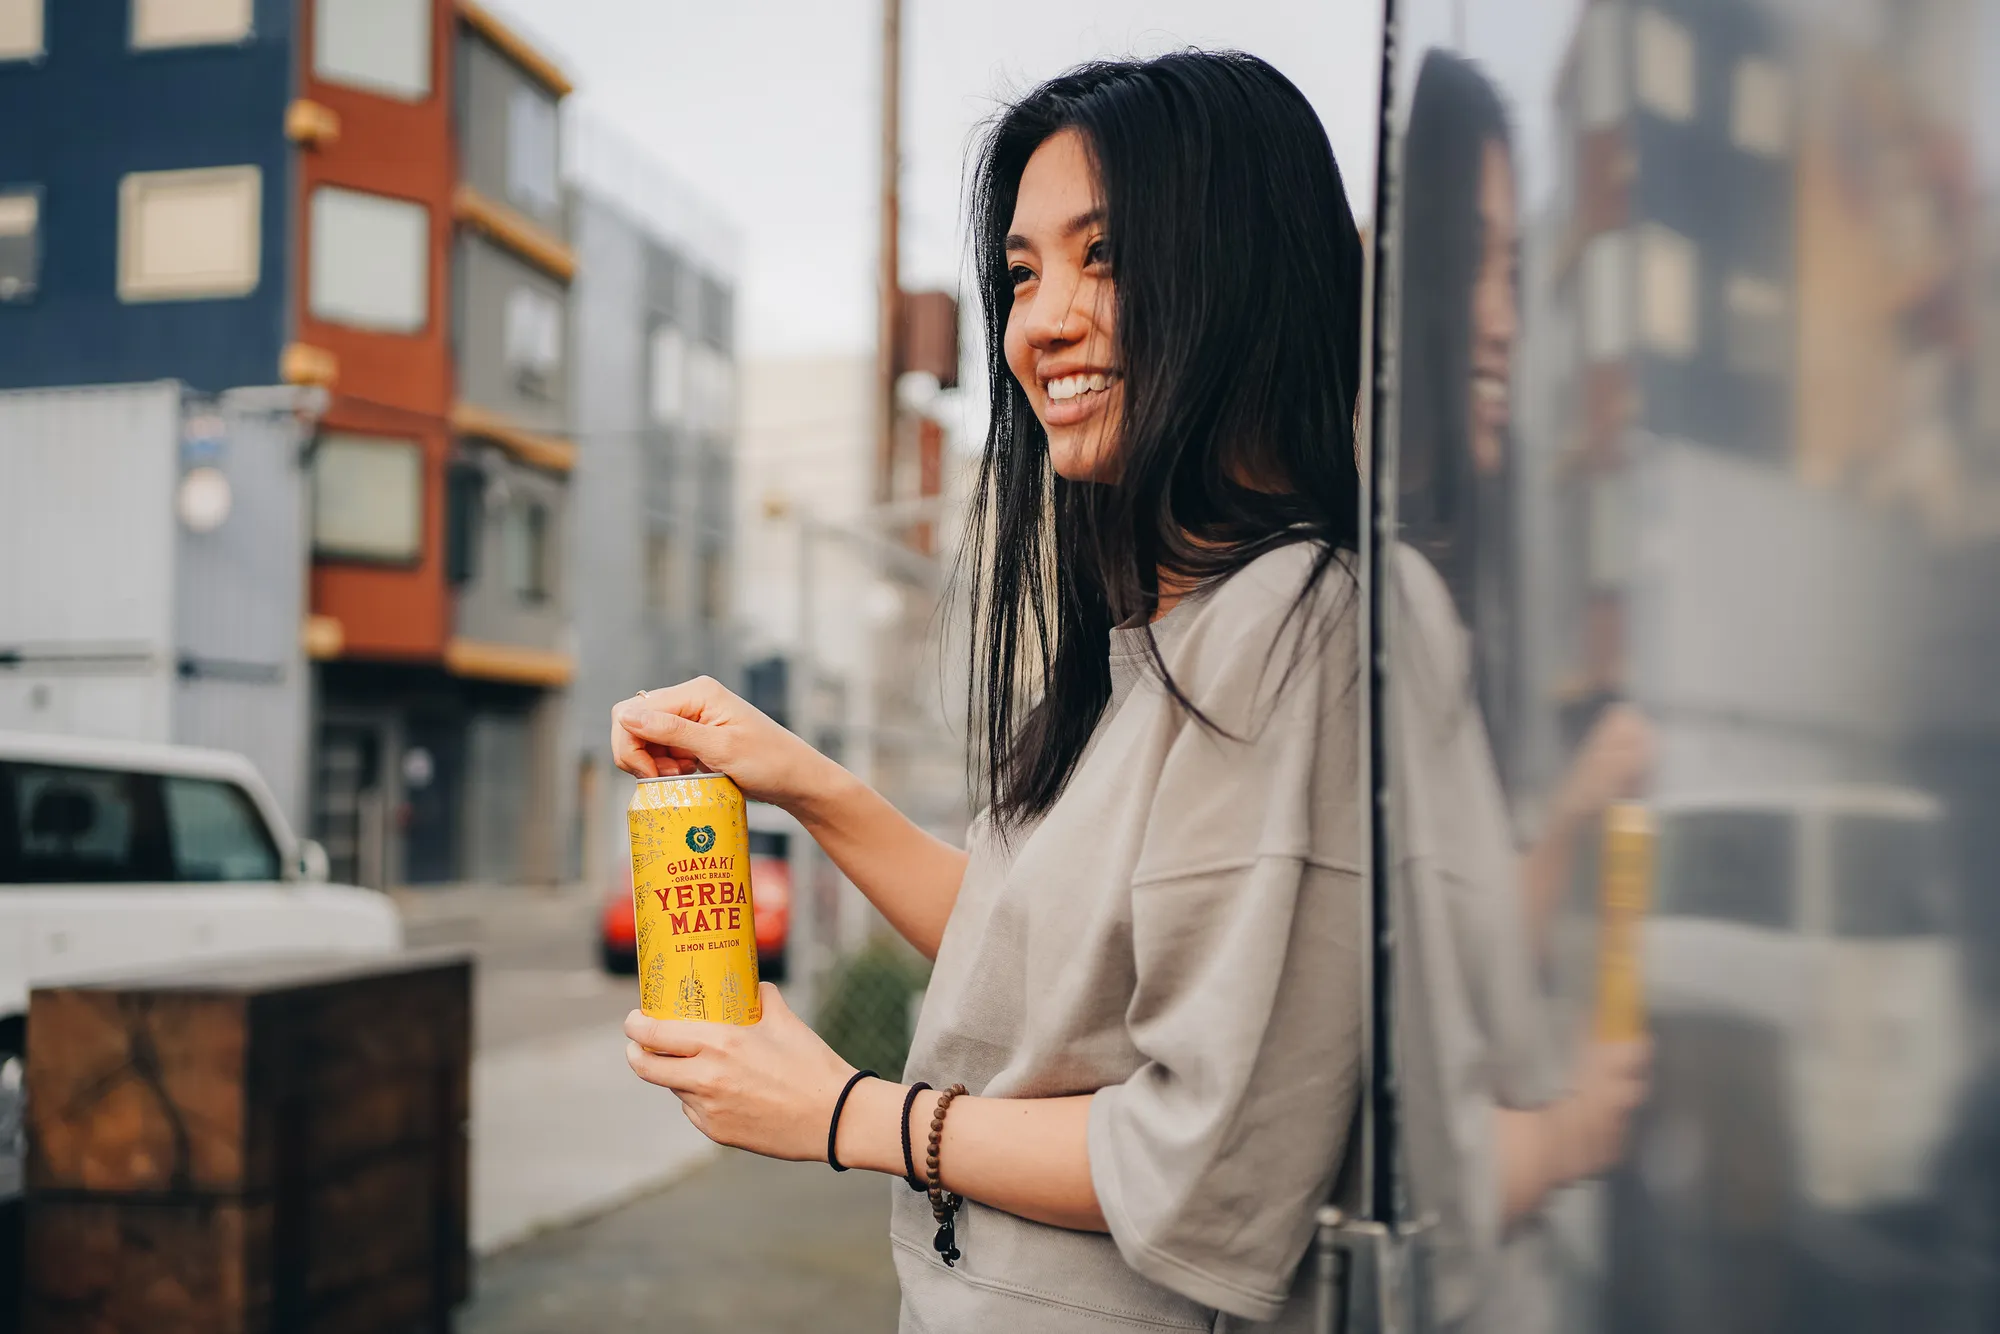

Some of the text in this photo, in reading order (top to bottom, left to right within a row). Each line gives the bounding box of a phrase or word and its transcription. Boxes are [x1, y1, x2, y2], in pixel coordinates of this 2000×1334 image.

[667, 854, 735, 875] GUAYAKÍ
[654, 882, 747, 911] YERBA
[669, 907, 740, 936] MATE
[675, 939, 740, 953] LEMON ELATION
